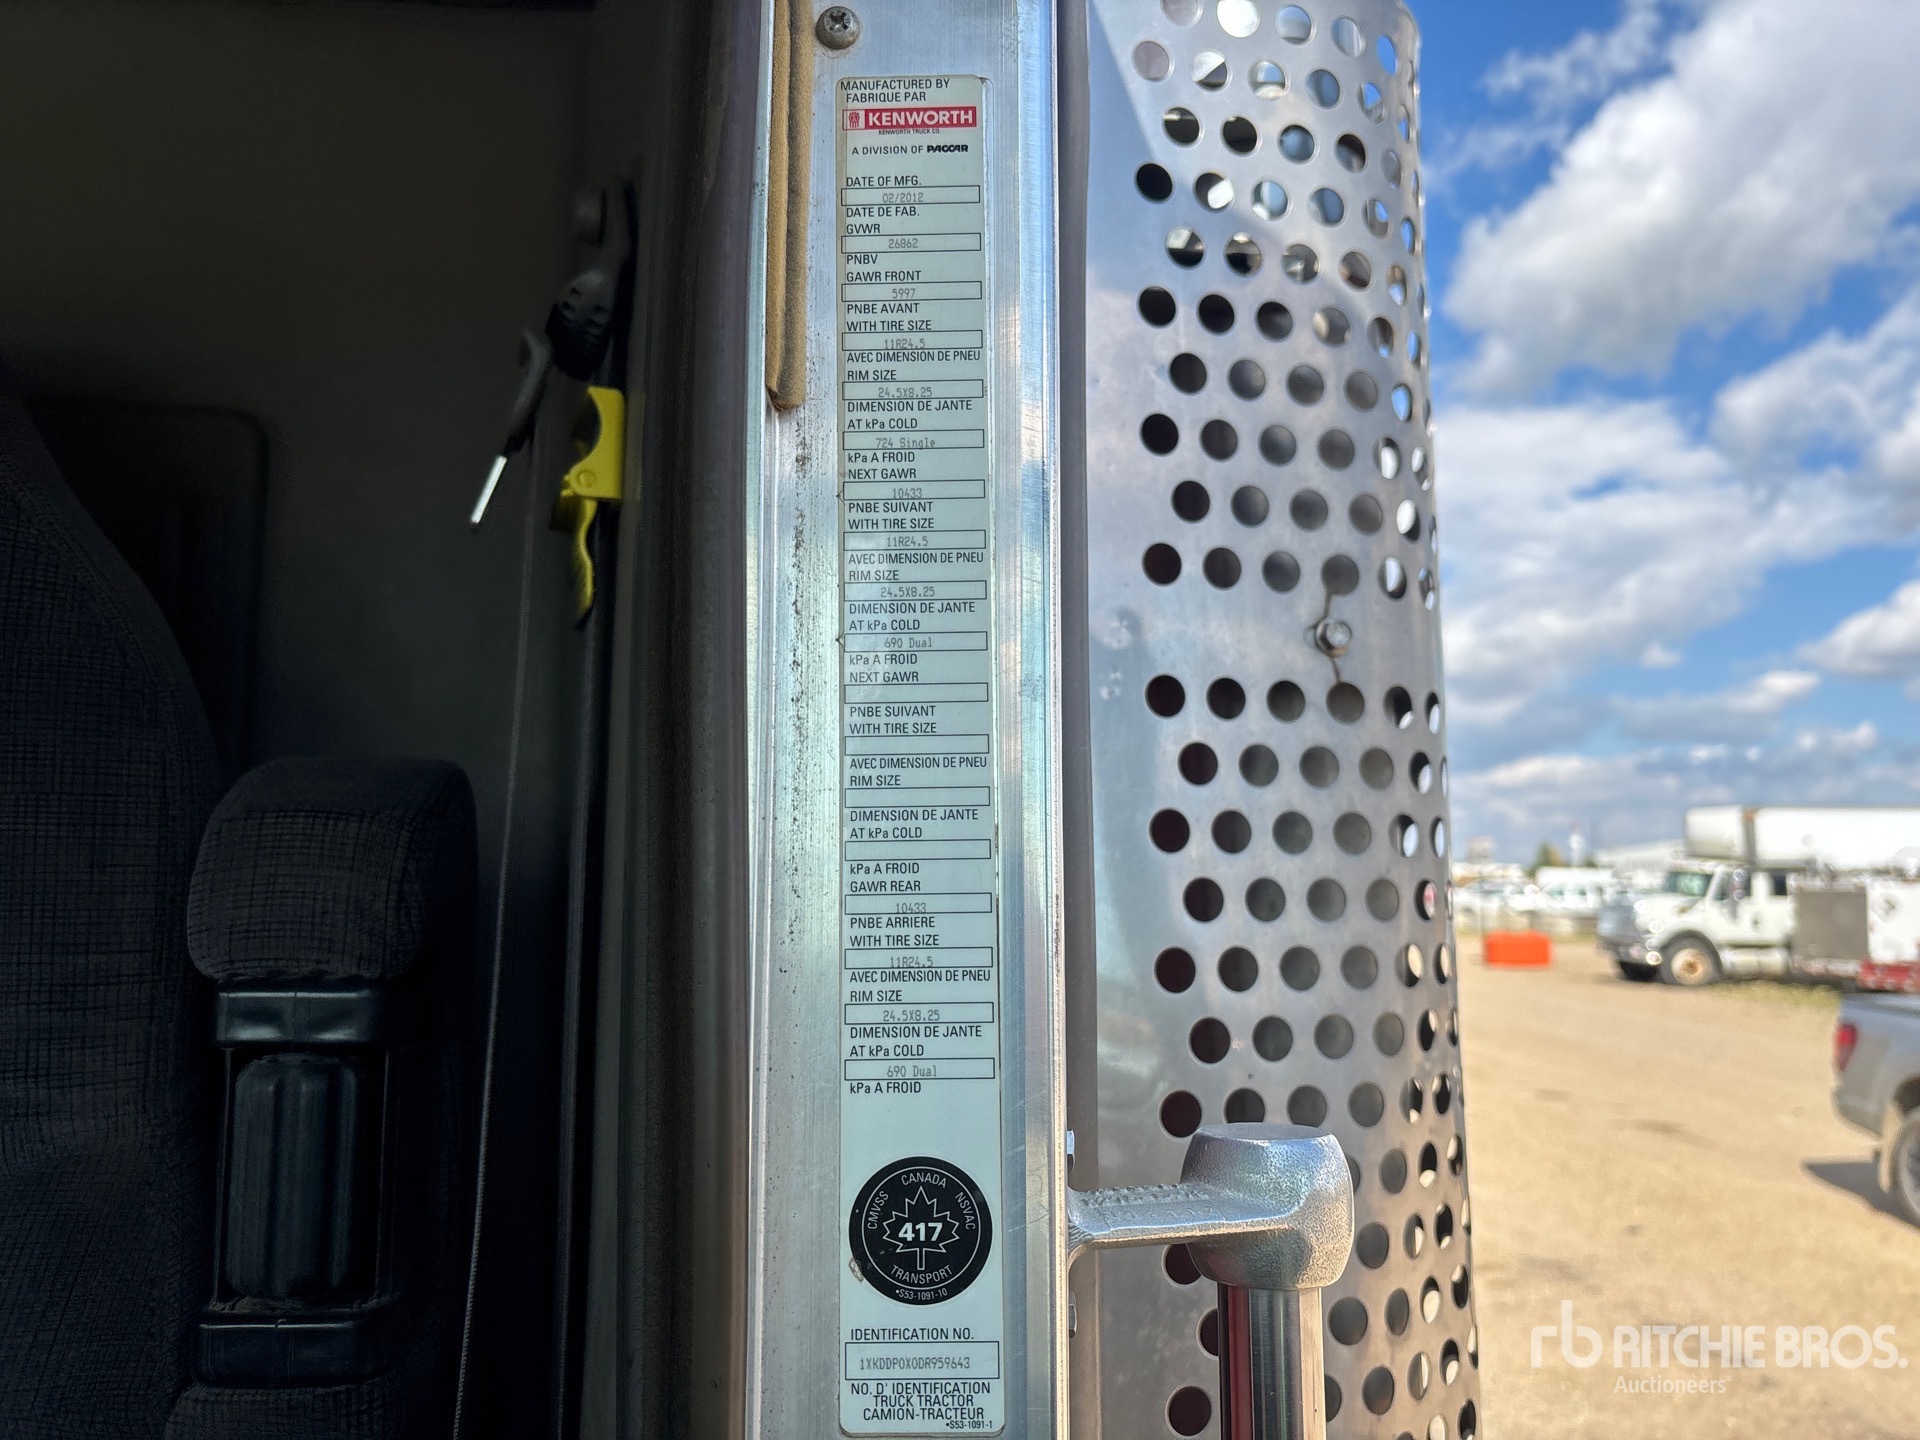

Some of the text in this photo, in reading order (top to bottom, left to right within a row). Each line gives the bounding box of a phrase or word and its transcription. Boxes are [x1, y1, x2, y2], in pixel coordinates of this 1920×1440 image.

[840, 79, 950, 91] MANUFACTURED BY
[846, 92, 926, 103] FABRIQUE PAR
[868, 110, 972, 126] KENWORTH
[852, 147, 859, 155] A
[862, 146, 908, 155] DIVISION
[926, 145, 969, 153] PACCAR
[846, 176, 921, 186] DATE OF MFG.
[882, 193, 924, 203] 02/2012
[846, 206, 919, 217] DATE DE FAB.
[846, 224, 880, 234] GVWR
[888, 238, 918, 248] 26862
[846, 254, 878, 265] PNBV
[846, 271, 921, 282] GAWR FRONT
[892, 288, 916, 299] 5997
[847, 303, 920, 314] PNBE AVANT
[847, 320, 932, 331] WITH TIRE SIZE
[885, 339, 925, 349] 11R24.5
[847, 350, 980, 363] AVEC DIMENSION DE PNEU
[848, 370, 896, 380] RIM SIZE
[878, 387, 932, 398] 24.5X8.25
[848, 400, 972, 412] DIMENSION DE JANTE
[848, 418, 917, 429] AT kPa COLD
[876, 437, 936, 450] 724 Single
[848, 452, 915, 463] kPa A FROID
[849, 468, 916, 479] NEXT GAWR
[892, 488, 922, 499] 10433
[849, 502, 933, 513] PNBE SUIVANT
[848, 518, 934, 529] WITH TIRE SIZE
[887, 536, 928, 547] 11R24.5
[849, 552, 984, 564] AVEC DIMENSION DE PNEU
[849, 570, 899, 581] RIM SIZE
[880, 587, 935, 598] 24.5X8.25
[850, 602, 975, 614] DIMENSION DE JANTE
[849, 620, 920, 631] AT kPa COLD
[884, 637, 932, 648] 690 Dual
[850, 654, 918, 665] kPa A FROID
[850, 672, 919, 683] NEXT GAWR
[850, 706, 936, 717] PNBE SUIVANT
[850, 723, 937, 734] WITH TIRE SIZE
[850, 757, 987, 769] AVEC DIMENSION DE PNEU
[850, 775, 901, 786] RIM SIZE
[850, 809, 978, 822] DIMENSION DE JANTE
[850, 827, 922, 839] AT kPa COLD
[850, 863, 920, 874] kPa A FROID
[850, 881, 921, 892] GAWR REAR
[896, 903, 926, 914] 10433
[850, 916, 936, 929] PNBE ARRIERE
[850, 935, 939, 947] WITH TIRE SIZE
[890, 956, 933, 968] 11R24.5
[850, 970, 990, 983] AVEC DIMENSION DE PNEU
[850, 990, 902, 1002] RIM SIZE
[883, 1010, 940, 1022] 24.5X8.25
[850, 1026, 982, 1038] DIMENSION DE JANTE
[850, 1045, 924, 1057] AT kPa COLD
[887, 1065, 937, 1077] 690 Dual
[850, 1082, 921, 1094] kPa A FROID
[901, 1172, 947, 1189] CANADA
[867, 1191, 889, 1230] CMVSS
[955, 1192, 976, 1230] NSVAC
[898, 1222, 942, 1242] 417
[890, 1264, 953, 1284] TRANSPORT
[851, 1328, 974, 1340] IDENTIFICATION NO.
[851, 1383, 872, 1395] NO.
[892, 1382, 990, 1394] IDENTIFICATION
[873, 1395, 973, 1407] TRUCK TRACTOR
[863, 1408, 984, 1420] CAMION-TRACTEUR
